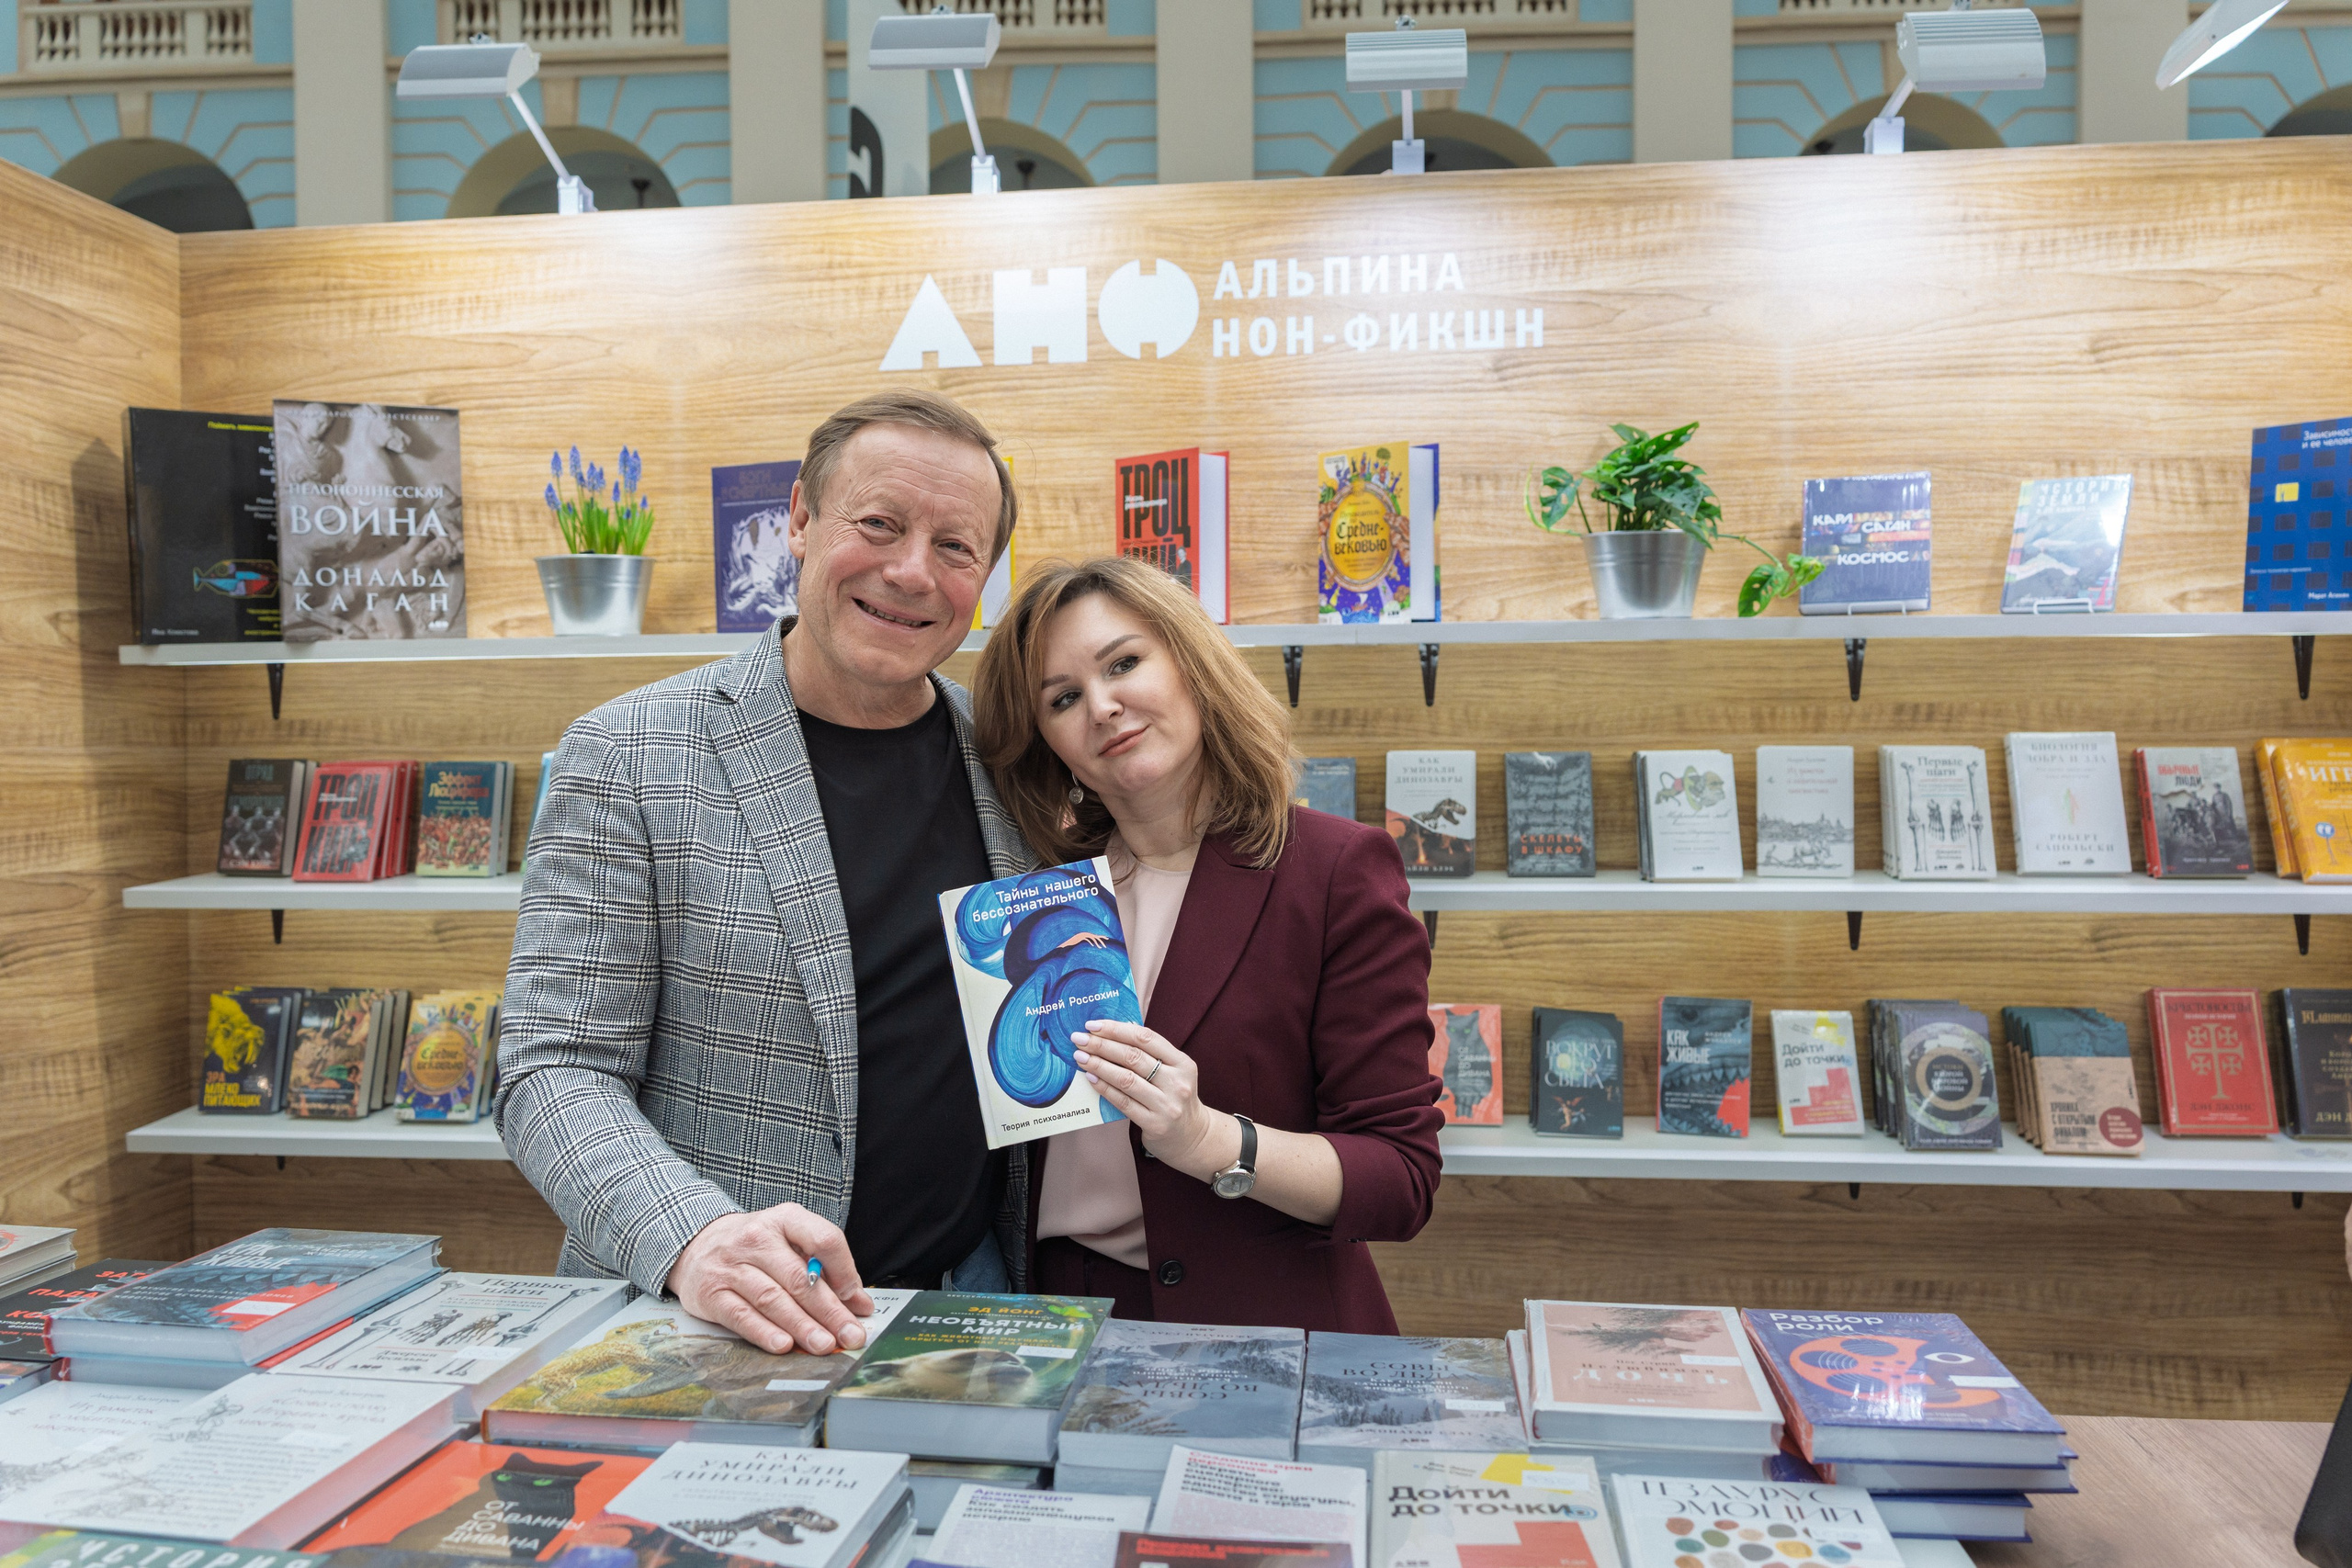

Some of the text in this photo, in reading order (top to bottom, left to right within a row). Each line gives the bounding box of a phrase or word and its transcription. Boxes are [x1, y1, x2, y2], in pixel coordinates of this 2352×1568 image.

[1213, 253, 1464, 300] АЛЬПИНА
[1213, 308, 1544, 358] НОН-ФИКШН
[2310, 440, 2321, 448] ее
[1120, 457, 1191, 547] ТРОЦ
[290, 500, 449, 537] ВОЙНА
[1813, 513, 1854, 526] КАРЛ
[1336, 520, 1384, 539] Средне-
[1861, 520, 1911, 533] САГАН
[1334, 537, 1387, 555] вековью
[1838, 551, 1910, 566] КОСМОС
[292, 567, 450, 588] ДОНАЛЬД
[295, 592, 448, 613] КАГАН
[1917, 756, 1963, 768] Первые
[438, 771, 482, 786] Эффект
[1926, 767, 1956, 777] шаги
[1396, 775, 1463, 784] ДИНОЗАВРЫ
[2176, 776, 2202, 786] ЛЮДИ
[313, 773, 381, 829] ТРОЦ
[1521, 834, 1583, 843] СКЕЛЕТЫ
[1521, 845, 1583, 854] В ШКАФУ
[995, 874, 1097, 904] Тайны нашего
[972, 886, 1099, 922] бессознательного
[1024, 988, 1120, 1017] Андрей Россохин
[1666, 1030, 1690, 1046] КАК
[1545, 1039, 1617, 1063] ВОКРУГ
[1666, 1047, 1711, 1064] ЖИВЫЕ
[1781, 1042, 1825, 1056] Дойти
[1784, 1055, 1846, 1068] до точки
[1001, 1106, 1091, 1133] Теория психоанализа
[222, 1243, 283, 1257] КАК
[191, 1254, 302, 1269] ЖИВЫЕ
[479, 1278, 573, 1291] Первые
[481, 1287, 548, 1296] шаги
[28, 1288, 99, 1299] ПАДА
[998, 1306, 1045, 1315] ЙОНГ
[909, 1314, 1085, 1332] НЕОБЪЯТНЫЙ
[1770, 1313, 1884, 1326] Разбор
[1775, 1321, 1854, 1332] роли
[961, 1325, 1021, 1337] МИР
[1370, 1361, 1449, 1371] СОВЫ
[1343, 1368, 1480, 1381] ВО ЛЬДАХ
[1143, 1390, 1227, 1400] СОВЫ
[1221, 1383, 1258, 1393] ВО
[754, 1450, 812, 1462] КАК
[699, 1459, 848, 1475] УМИРАЛИ
[662, 1470, 860, 1490] ДИНОЗАВРЫ
[1388, 1484, 1510, 1503] Дойти
[1641, 1480, 1833, 1504] ТЕЗАУРУС
[485, 1500, 519, 1511] ОТ
[1391, 1503, 1572, 1517] до точки
[458, 1519, 497, 1532] ДО
[472, 1510, 584, 1531] САВАННЫ
[441, 1531, 540, 1551] ДИВАНА
